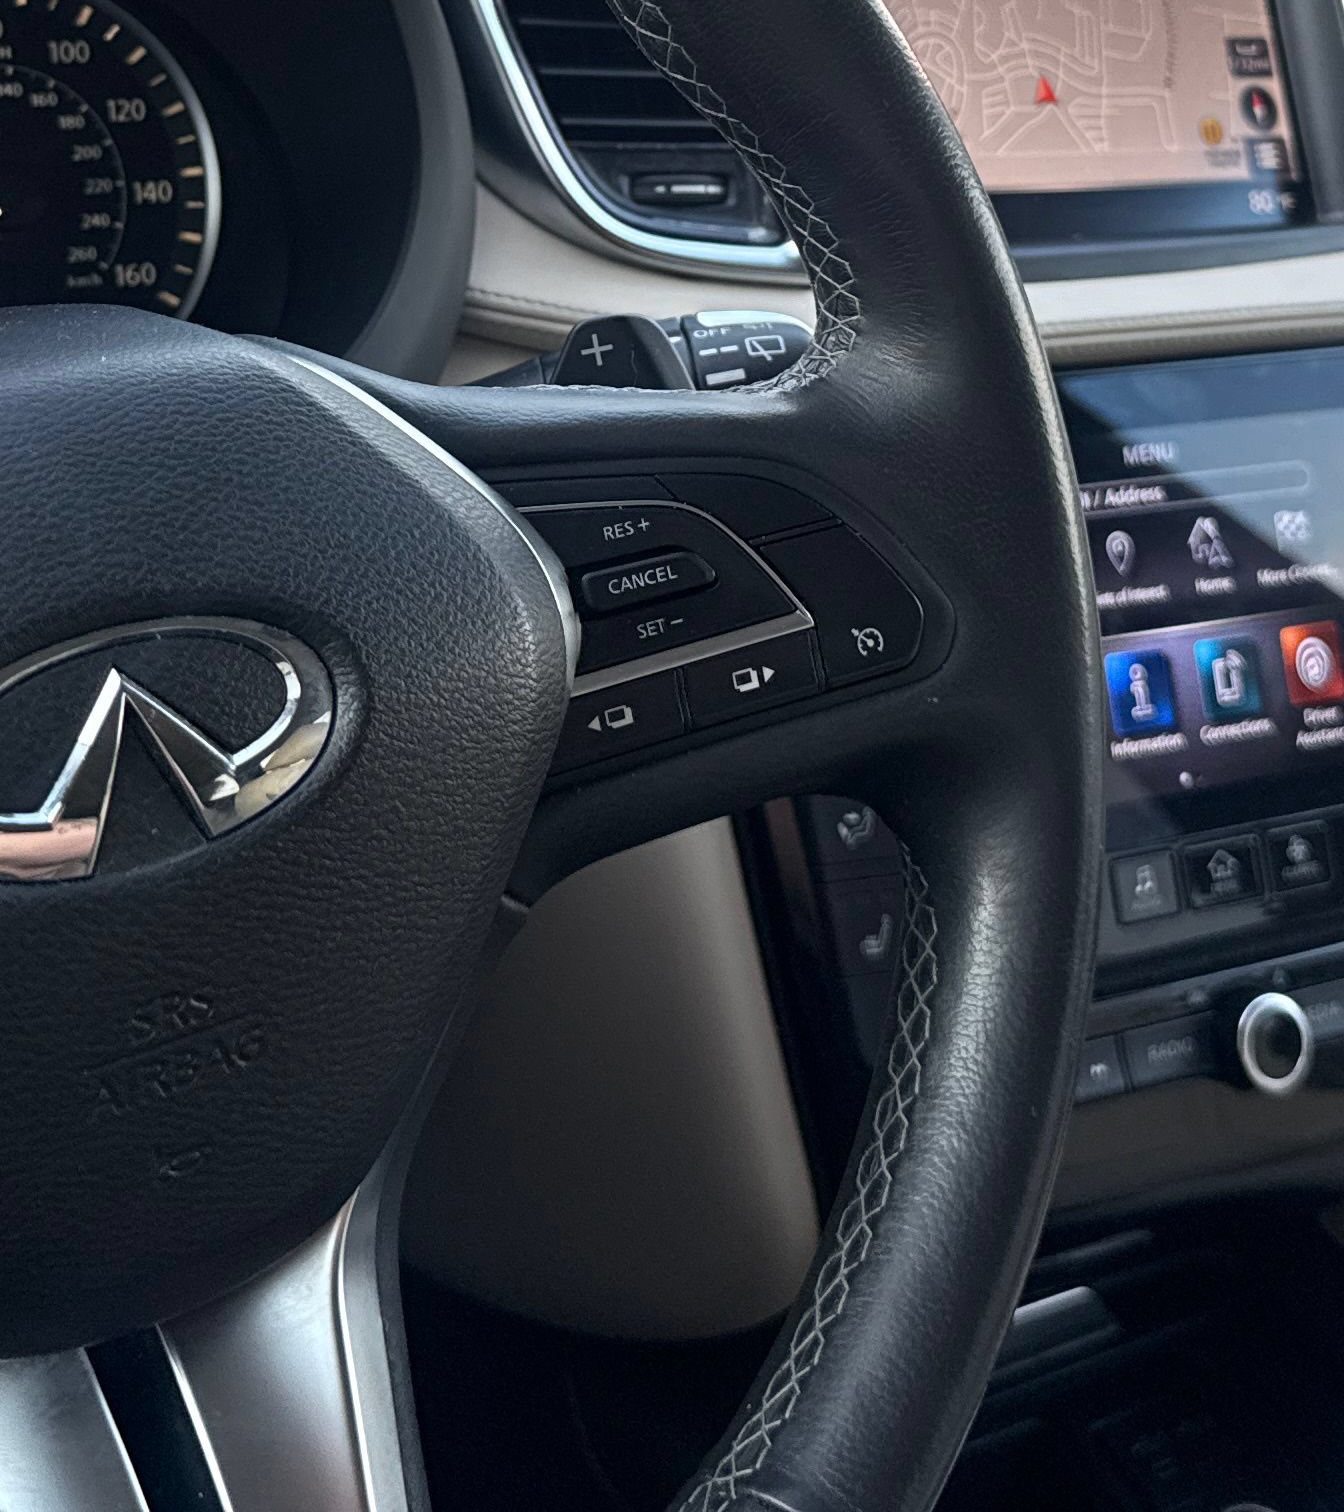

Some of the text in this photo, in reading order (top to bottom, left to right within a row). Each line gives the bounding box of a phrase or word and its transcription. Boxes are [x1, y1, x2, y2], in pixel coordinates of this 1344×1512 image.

[47, 40, 90, 65] 100
[105, 98, 146, 123] 120
[132, 180, 173, 204] 140
[113, 262, 157, 287] 160
[693, 327, 731, 338] OFF
[1123, 440, 1175, 467] MENU
[603, 522, 635, 540] RES
[607, 565, 678, 595] CANCEL
[636, 619, 666, 640] SET
